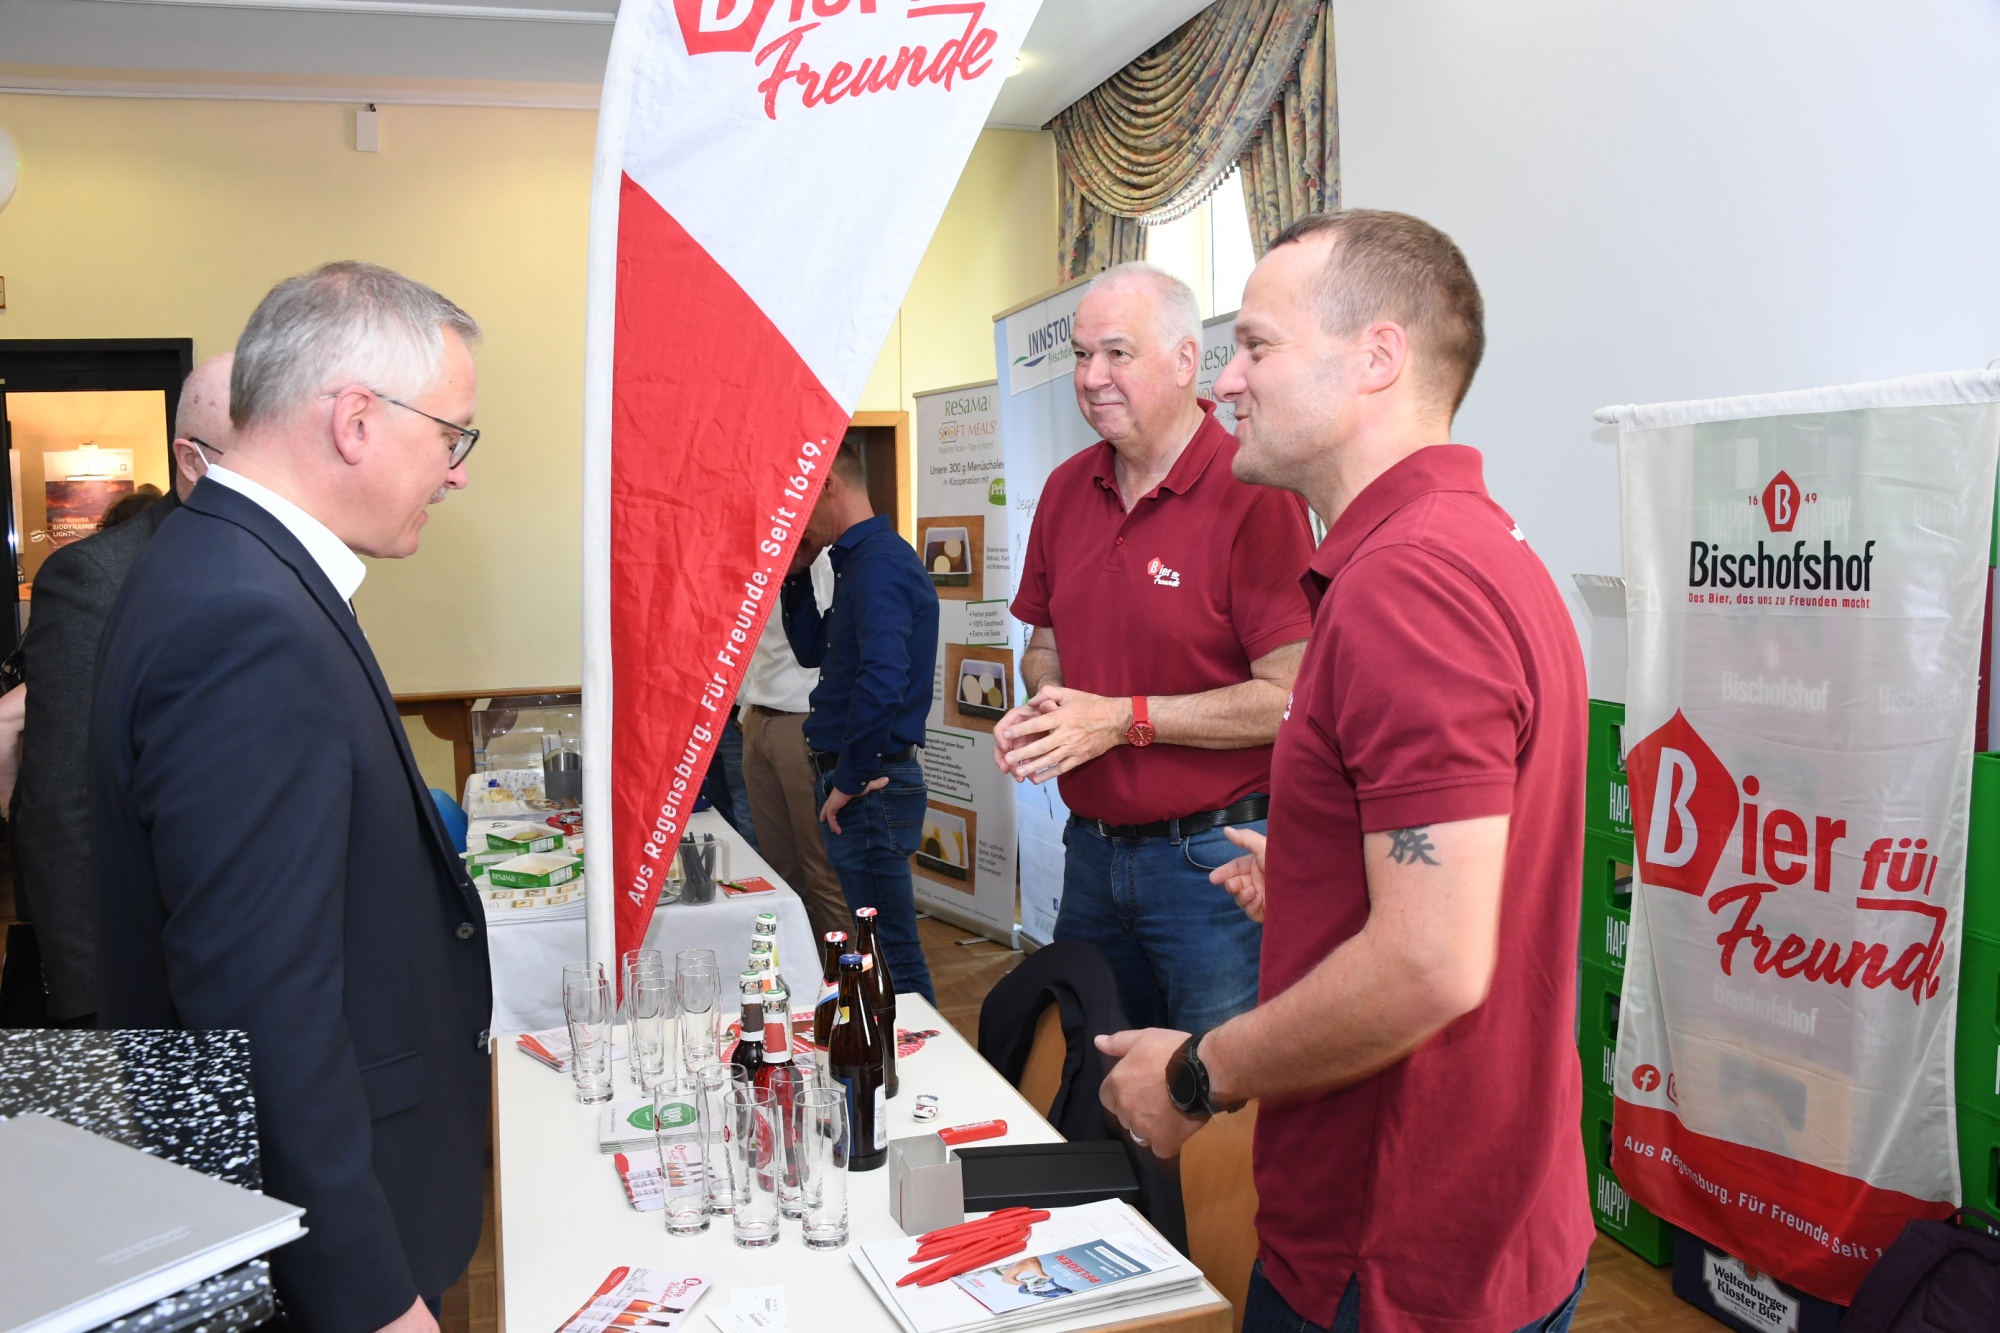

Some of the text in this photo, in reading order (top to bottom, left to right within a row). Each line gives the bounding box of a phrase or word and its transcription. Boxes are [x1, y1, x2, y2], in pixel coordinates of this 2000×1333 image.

[755, 22, 998, 120] Freunde
[1028, 311, 1076, 357] INNSTOL
[949, 462, 961, 474] 300
[949, 475, 980, 487] Kooperation
[1748, 495, 1758, 506] 16
[1804, 493, 1817, 504] 49
[1688, 540, 1876, 592] Bischofshof
[1688, 593, 1870, 609] Das Bier, das uns zu Freunden macht
[627, 438, 827, 907] Aus Regensburg. Für Freunde. Seit 1649.
[1645, 746, 1846, 893] Bier
[1597, 1173, 1631, 1227] HAPPY
[1624, 1135, 1654, 1157] Aus
[1660, 1147, 1732, 1204] Regensburg.
[1738, 1192, 1765, 1214] Für
[1771, 1204, 1829, 1248] Freunde.
[1832, 1236, 1869, 1260] Seit
[1054, 1254, 1102, 1284] PFLEGEN
[1713, 1263, 1788, 1314] Weltenburger
[1717, 1279, 1757, 1310] Kloster
[1758, 1301, 1782, 1324] Bier
